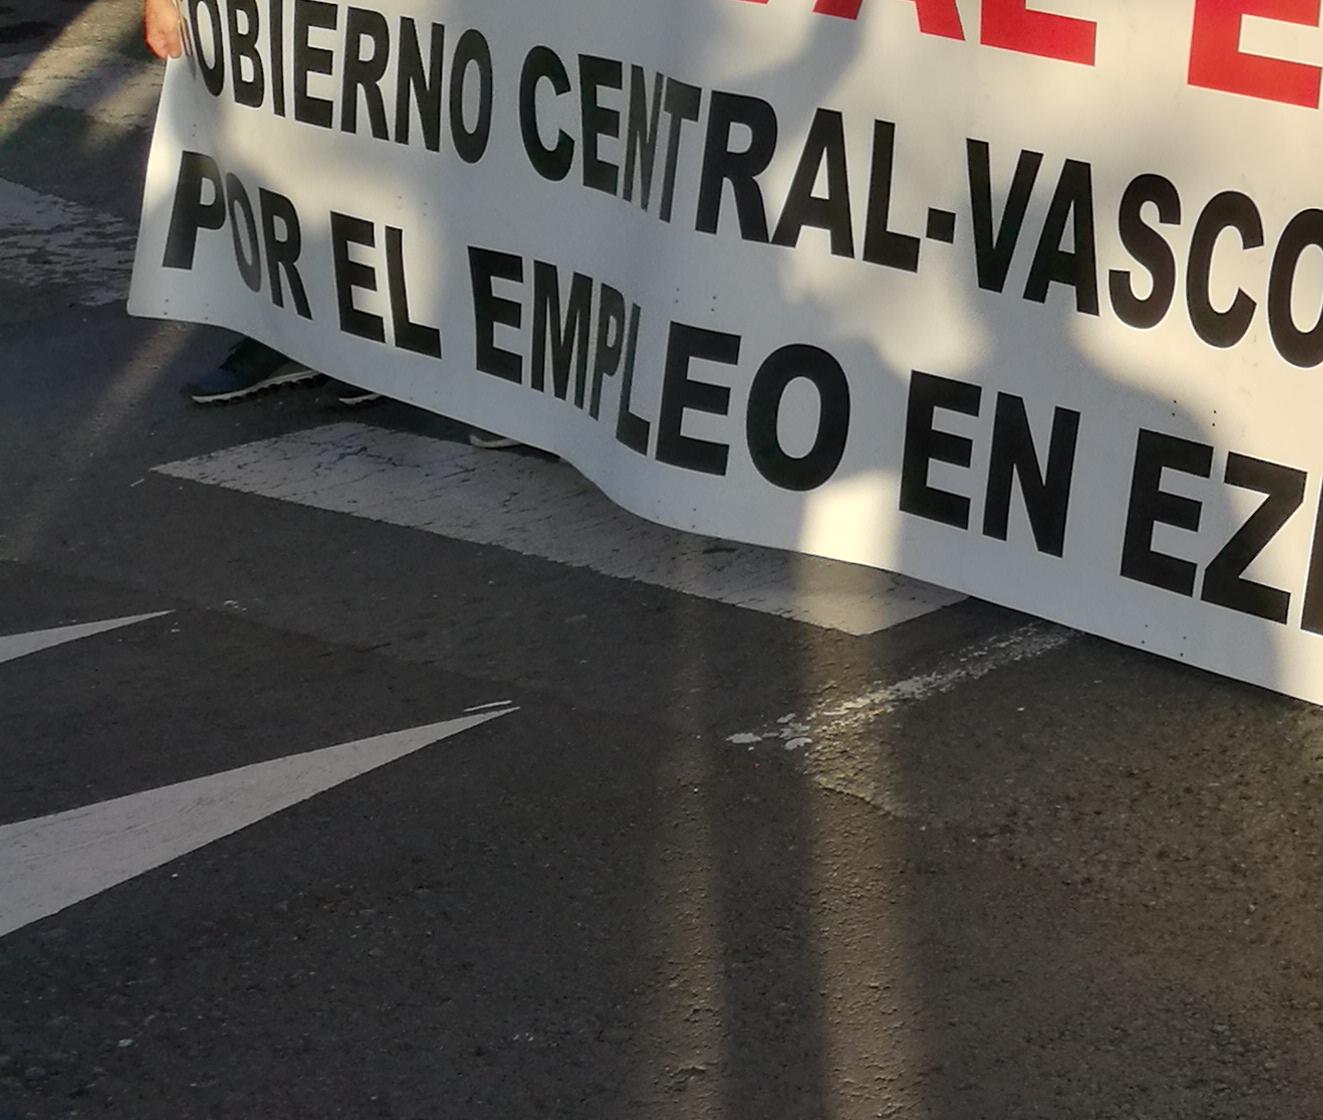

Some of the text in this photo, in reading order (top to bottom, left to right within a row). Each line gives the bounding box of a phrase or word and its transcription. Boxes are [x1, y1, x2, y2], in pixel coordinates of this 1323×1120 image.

[161, 149, 314, 321] POR
[329, 210, 443, 360] EL
[466, 244, 852, 493] EMPLEO
[898, 369, 1082, 559] EN
